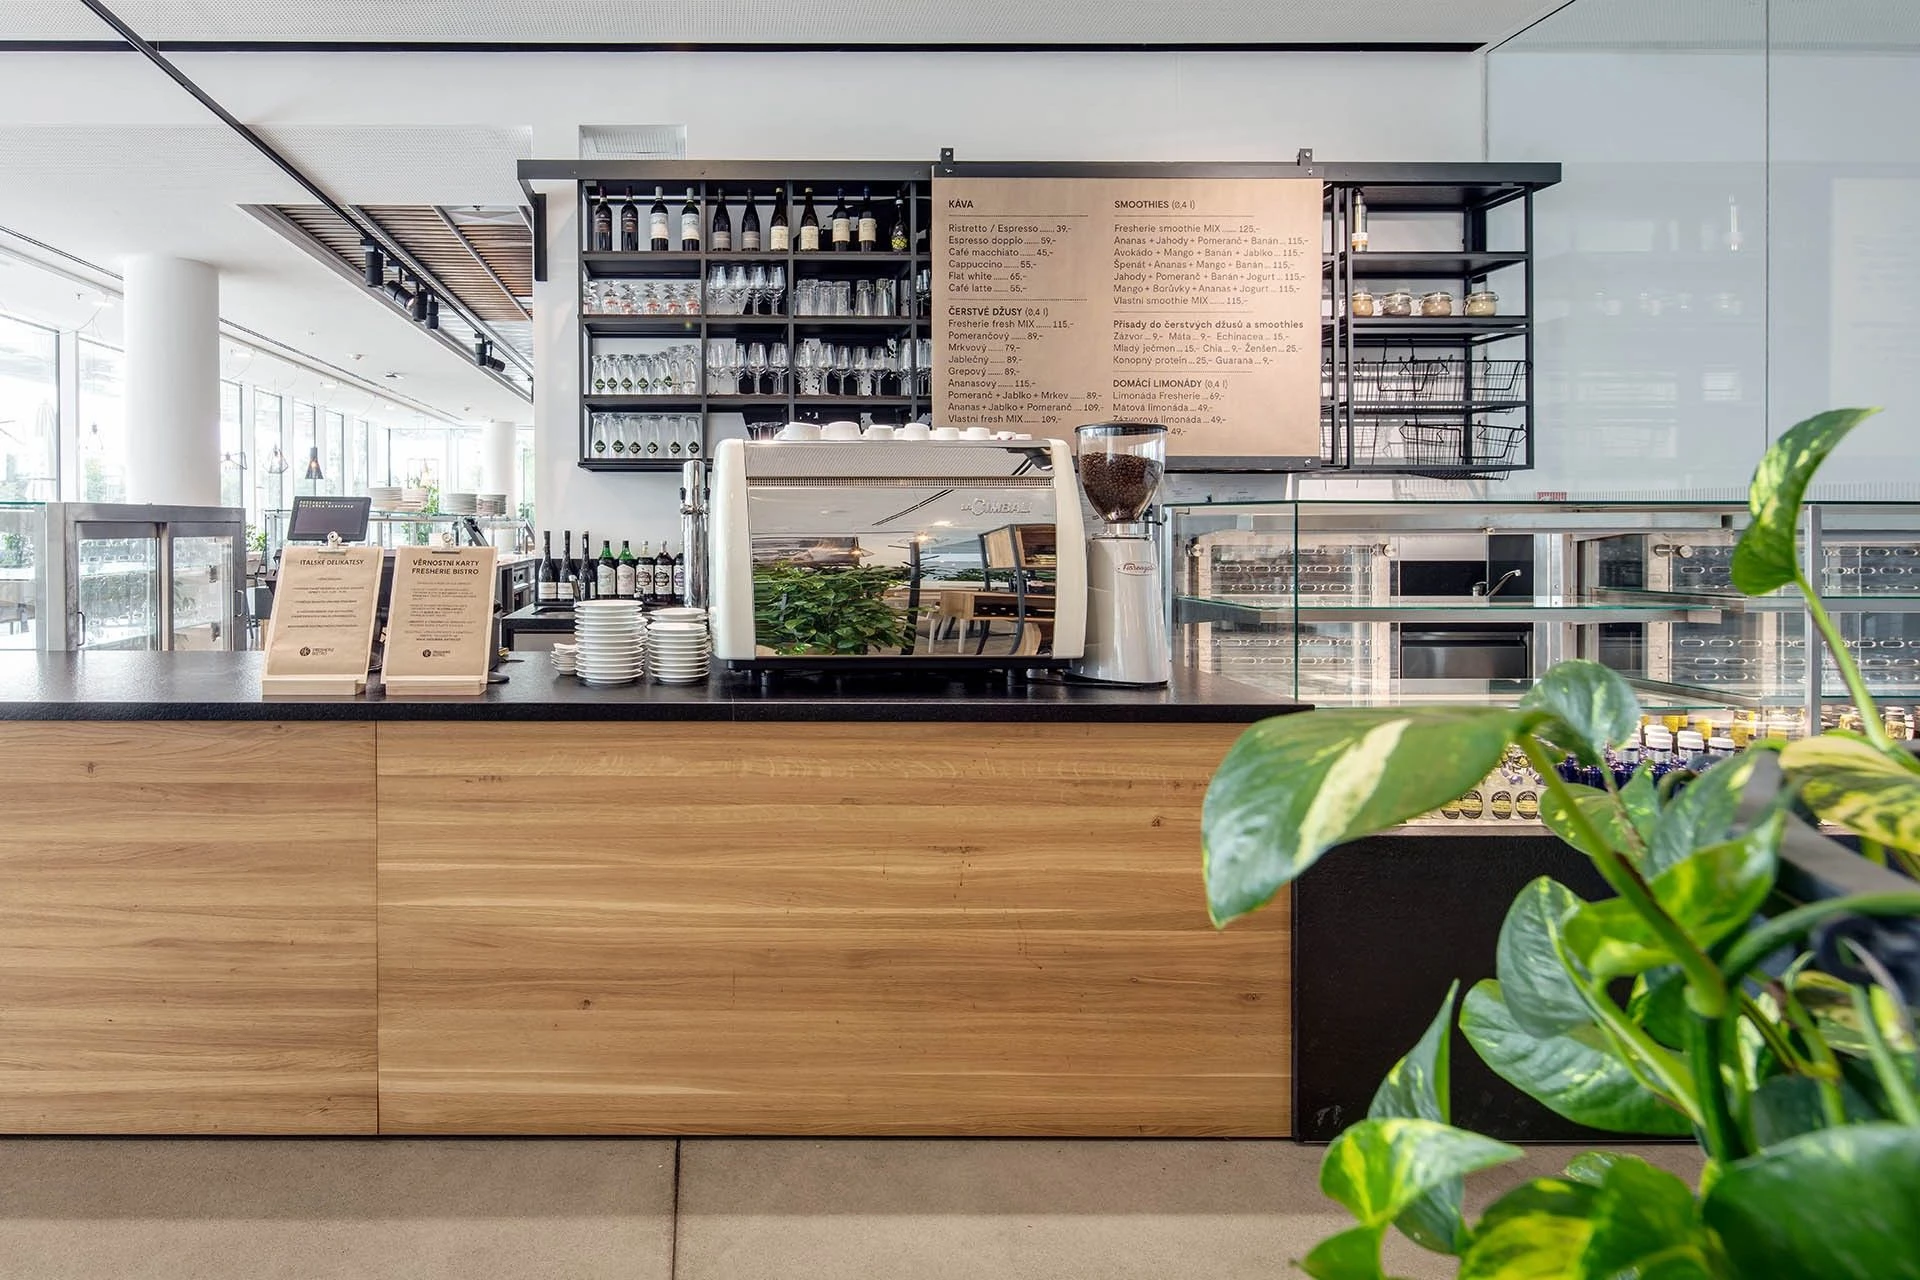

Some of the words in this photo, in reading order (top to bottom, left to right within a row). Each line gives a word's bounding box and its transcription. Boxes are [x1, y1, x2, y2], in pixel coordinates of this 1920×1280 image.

[949, 199, 974, 208] KÁVA
[1114, 200, 1169, 208] SMOOTHIES
[949, 224, 987, 232] Ristretto
[998, 224, 1038, 234] Espresso
[1114, 224, 1156, 232] Fresherie
[1159, 224, 1200, 232] smoothie
[1204, 224, 1220, 232] MIX
[949, 236, 988, 246] Espresso
[992, 236, 1023, 246] doppio
[1114, 236, 1146, 244] Ananas
[1156, 236, 1188, 246] Jahody
[1198, 236, 1242, 244] Pomeranč
[949, 248, 969, 256] Café
[972, 248, 1019, 256] macchiato
[1114, 248, 1153, 256] Avokádo
[1164, 248, 1194, 258] Mango
[1243, 248, 1273, 256] Jablko
[949, 260, 1002, 269] Cappuccino
[1114, 258, 1145, 270] Špenát
[1154, 260, 1186, 268] Ananas
[1196, 260, 1226, 270] Mango
[949, 272, 964, 280] Flat
[968, 272, 992, 280] white
[1114, 272, 1146, 282] Jahody
[1156, 272, 1200, 280] Pomeranč
[949, 283, 969, 292] Café
[972, 284, 992, 292] latte
[1114, 284, 1143, 294] Mango
[1198, 284, 1231, 292] Ananas
[1146, 296, 1188, 304] smoothie
[1191, 296, 1208, 304] MIX
[948, 305, 989, 315] ČERSTVÉ
[993, 305, 1022, 315] DŽUSY
[949, 319, 989, 328] Fresherie
[993, 320, 1015, 328] fresh
[1018, 320, 1035, 328] MIX
[1150, 320, 1161, 328] do
[1164, 320, 1212, 330] čerstvých
[1215, 320, 1243, 328] džusů
[1255, 320, 1303, 328] smoothies
[949, 331, 1009, 342] Pomerančový
[949, 343, 987, 353] Mrkvový
[1143, 344, 1175, 354] ječmen
[1203, 344, 1222, 352] Chia
[949, 355, 989, 365] Jablečný
[1113, 356, 1152, 366] Konopný
[1155, 355, 1187, 366] protein
[948, 367, 986, 377] Grepový
[1113, 377, 1151, 387] DOMÁCÍ
[1154, 378, 1201, 387] LIMONÁDY
[948, 391, 992, 400] Pomeranč
[1003, 391, 1031, 400] Jablko
[1041, 392, 1068, 400] Mrkev
[1113, 391, 1156, 400] Limonáda
[1159, 392, 1200, 400] Fresherie
[948, 403, 980, 412] Ananas
[988, 404, 1017, 412] Jablko
[1027, 403, 1072, 412] Pomeranč
[1148, 403, 1188, 412] limonáda
[981, 415, 1003, 423] fresh
[1006, 415, 1023, 423] MIX
[1161, 415, 1201, 424] limonáda
